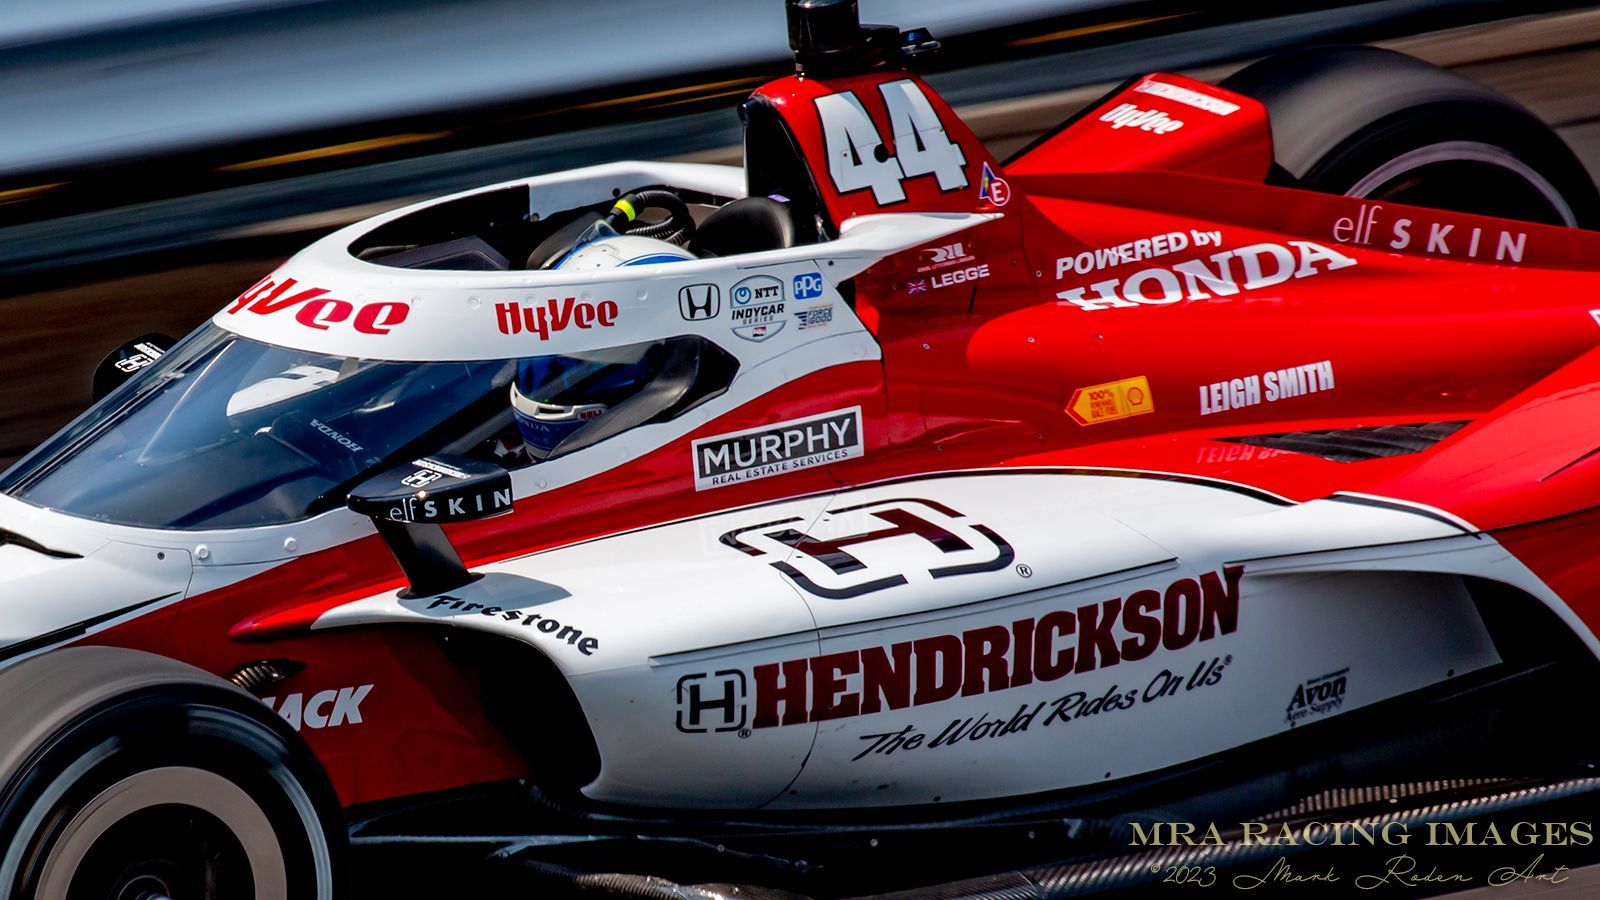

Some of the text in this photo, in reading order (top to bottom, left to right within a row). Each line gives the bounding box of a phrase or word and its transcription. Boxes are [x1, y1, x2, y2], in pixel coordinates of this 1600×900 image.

[814, 78, 968, 205] 44
[991, 182, 1005, 202] E
[1056, 229, 1222, 279] POWERED by
[1333, 204, 1526, 262] elf SKIN
[754, 286, 779, 299] NTT
[795, 276, 821, 297] PPG
[932, 264, 990, 288] LEGGE
[1056, 241, 1358, 311] HONDA
[495, 297, 618, 341] HyVee
[731, 303, 785, 320] INDYCAR
[1200, 360, 1335, 415] LEIGH SMITH
[309, 418, 364, 453] HONDA
[703, 418, 851, 475] MURPHY
[712, 449, 849, 485] REAL ESTATE SERVICES
[389, 488, 511, 522] elf SKIN
[426, 596, 599, 656] Firestone
[752, 565, 1244, 729] HENDRICKSON
[851, 725, 922, 762] The
[927, 702, 1047, 749] World
[1043, 685, 1135, 727] Rides
[1141, 669, 1181, 703] On
[1286, 676, 1347, 713] Avon
